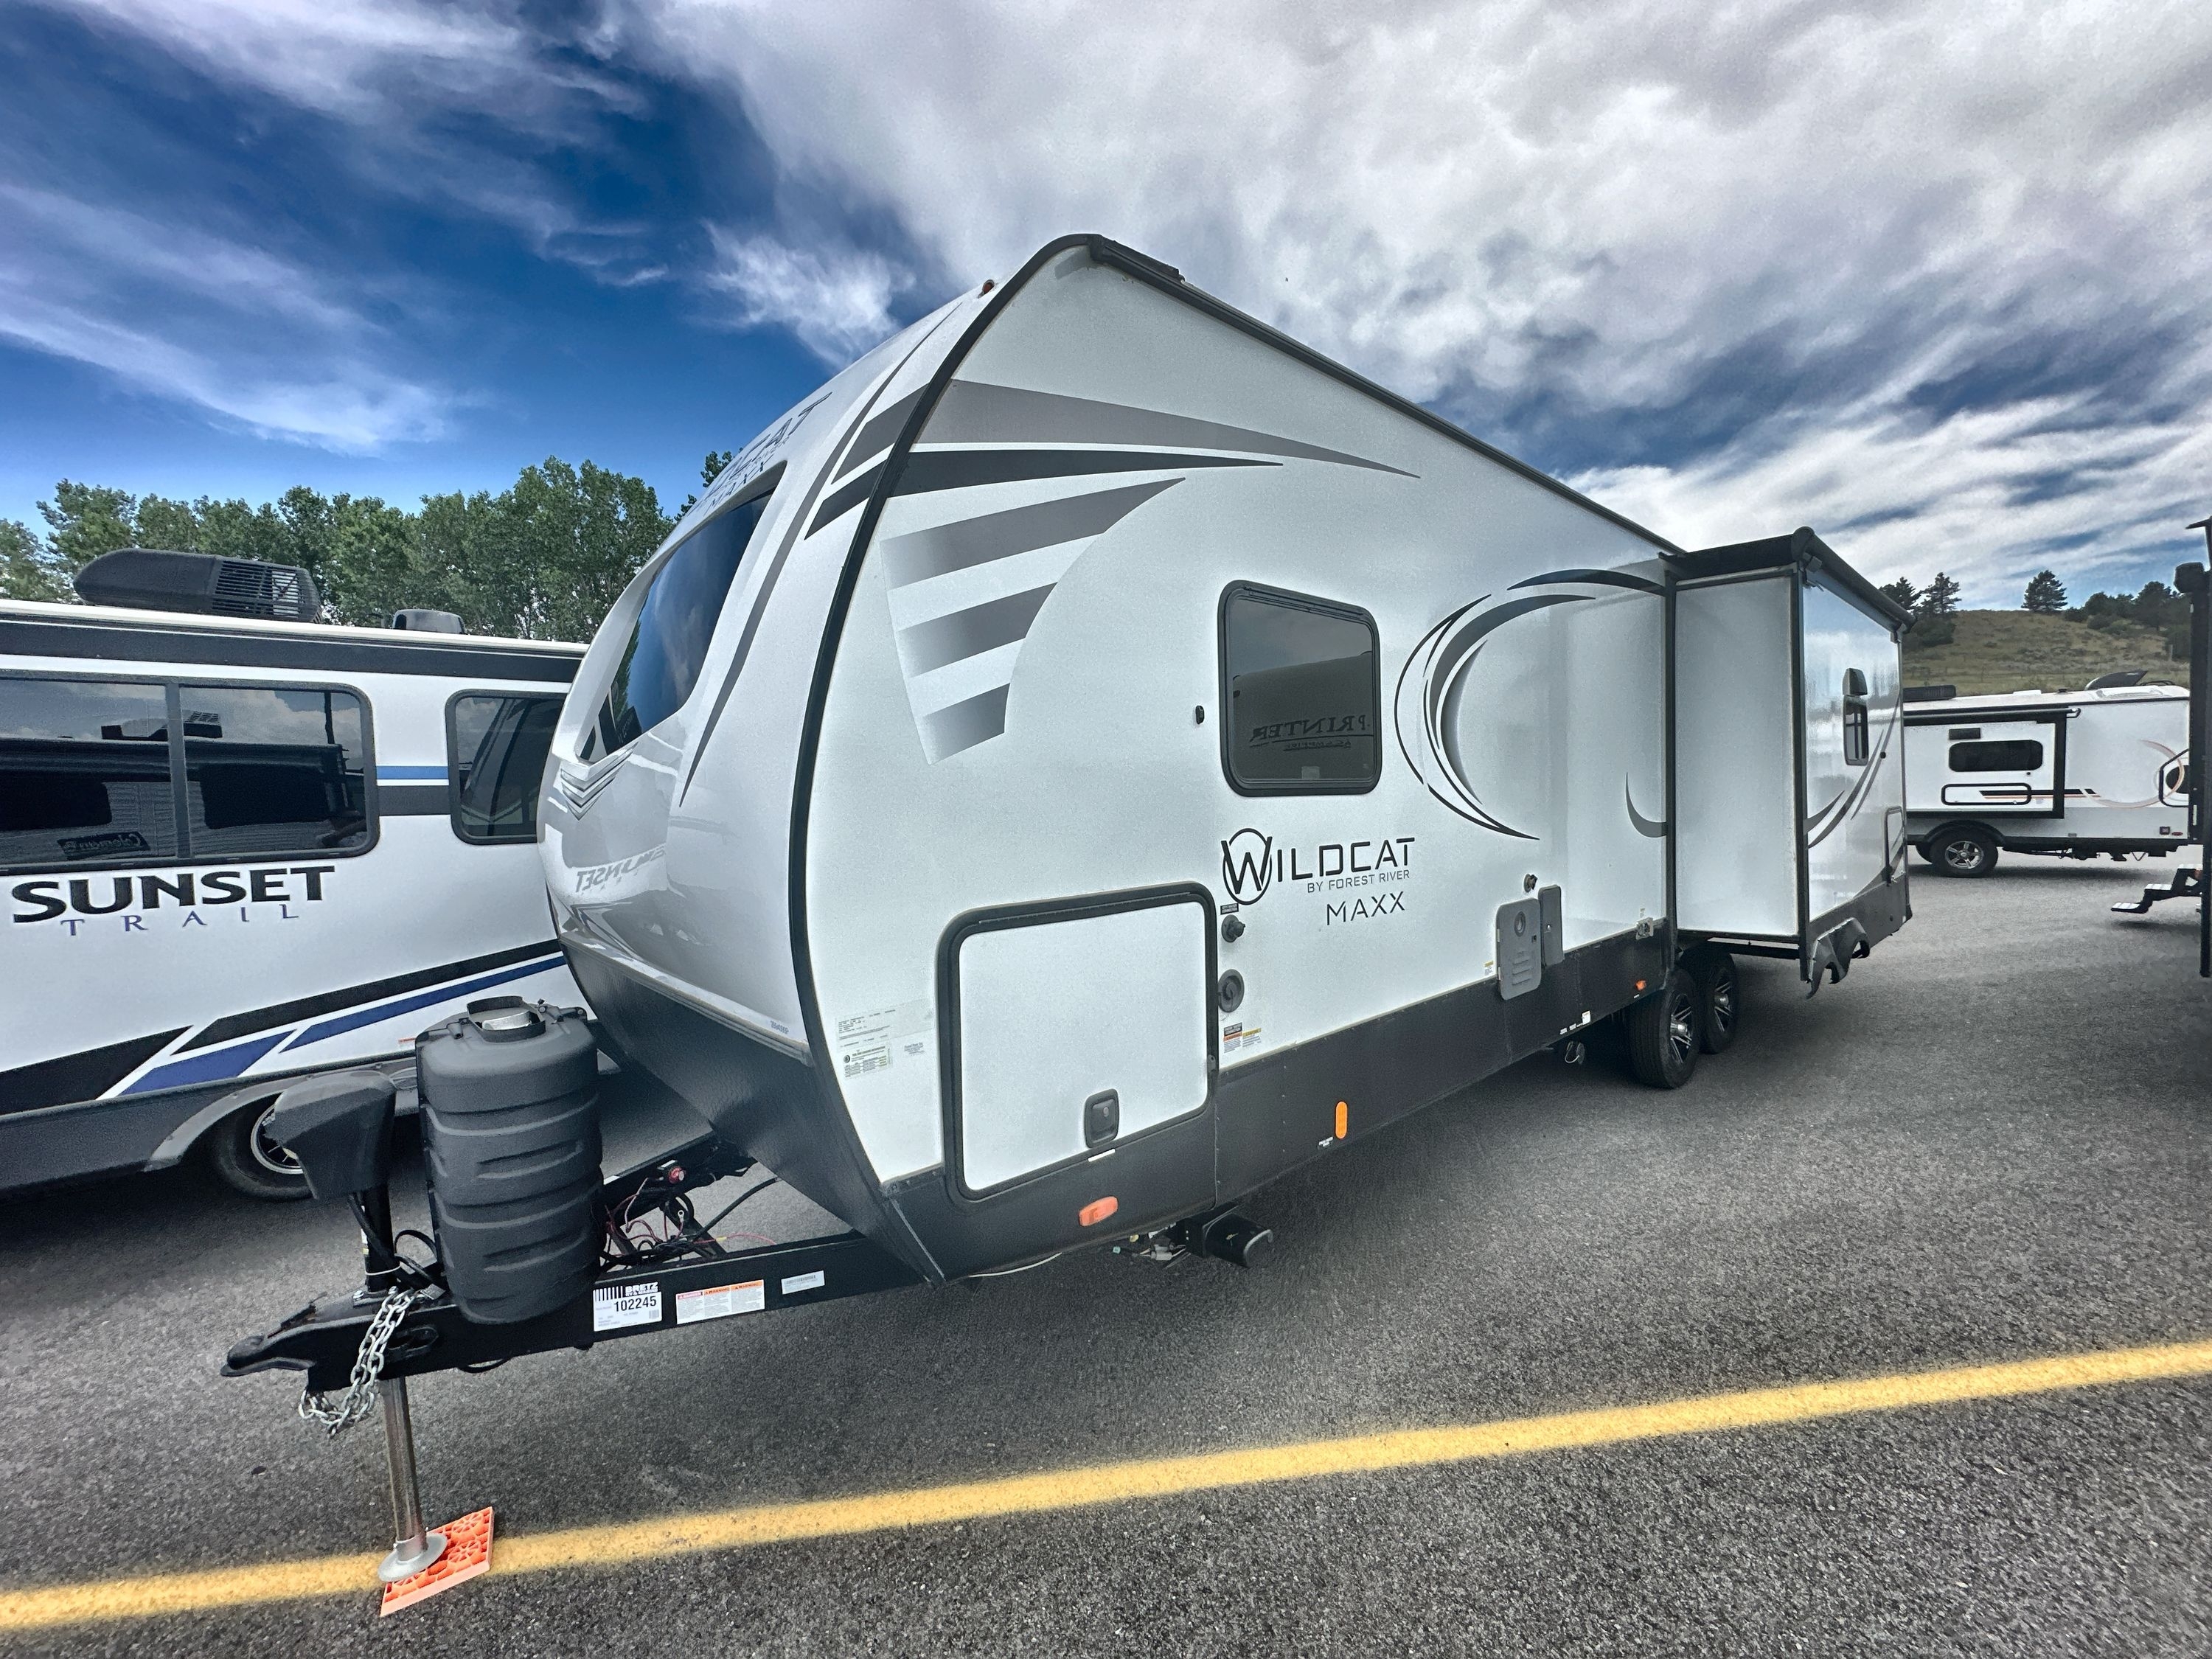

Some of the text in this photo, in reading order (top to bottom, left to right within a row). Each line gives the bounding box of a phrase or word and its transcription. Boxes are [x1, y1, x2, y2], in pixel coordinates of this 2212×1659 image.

[1220, 835, 1415, 895] WILDCAT
[1307, 869, 1410, 893] BY FOREST RIVER
[12, 866, 335, 923] SUNSET
[1327, 891, 1405, 925] MAXX
[60, 903, 299, 936] TRAIL
[613, 1295, 657, 1312] 102245
[625, 1281, 658, 1293] BRETZ
